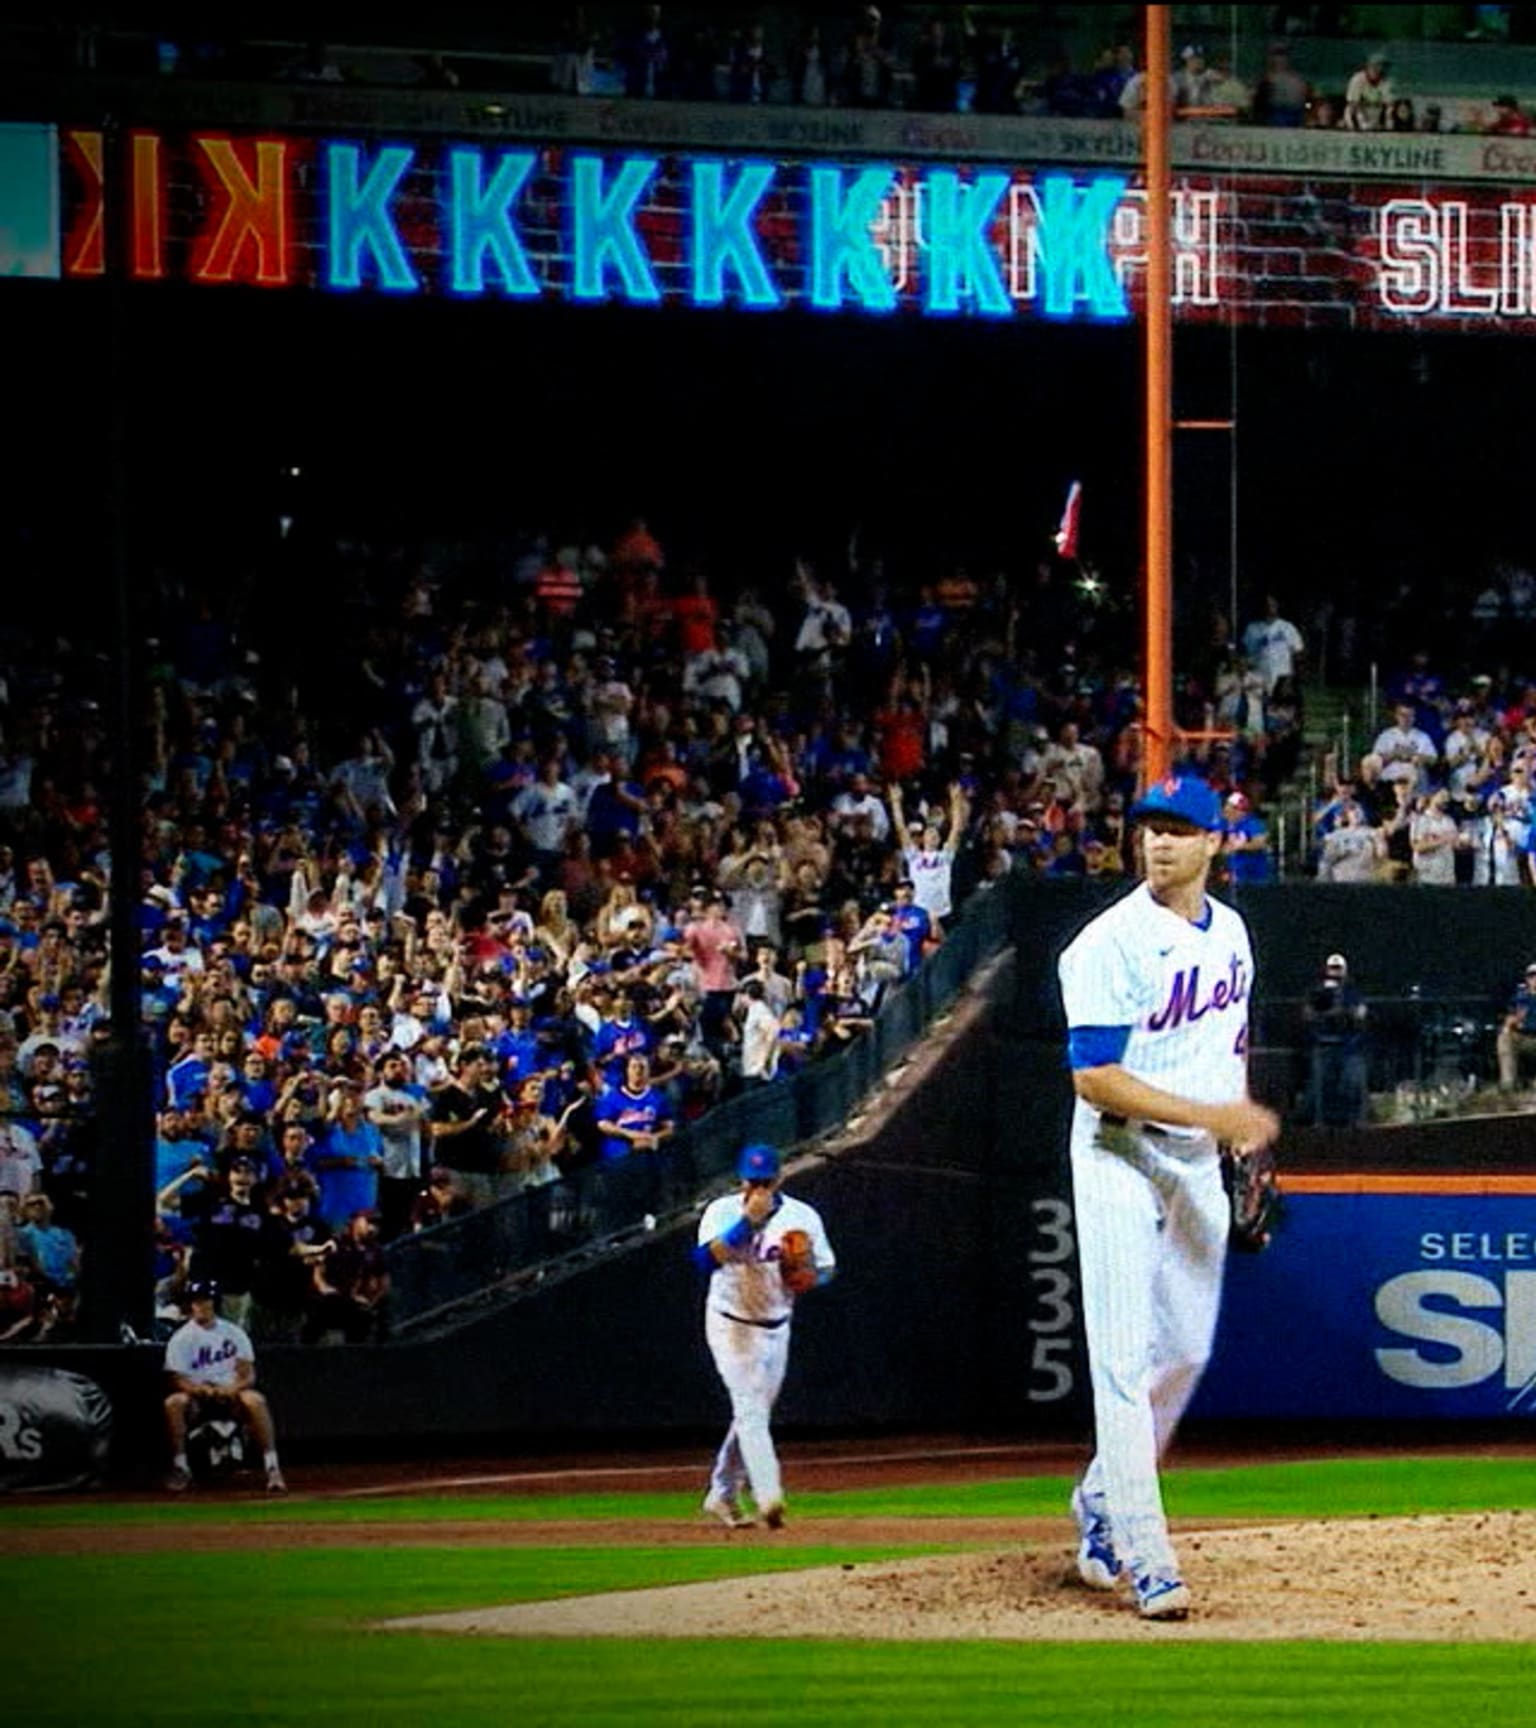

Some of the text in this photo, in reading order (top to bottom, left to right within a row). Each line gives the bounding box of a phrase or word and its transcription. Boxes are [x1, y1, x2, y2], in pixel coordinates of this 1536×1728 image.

[1060, 132, 1145, 157] SKYLIN
[1350, 145, 1446, 170] SKYLINE
[327, 143, 419, 289] K
[451, 151, 542, 295] K
[573, 156, 662, 301] K
[692, 163, 781, 306] K
[813, 169, 898, 310] K
[927, 171, 1013, 316] K
[1028, 1198, 1075, 1402] 335
